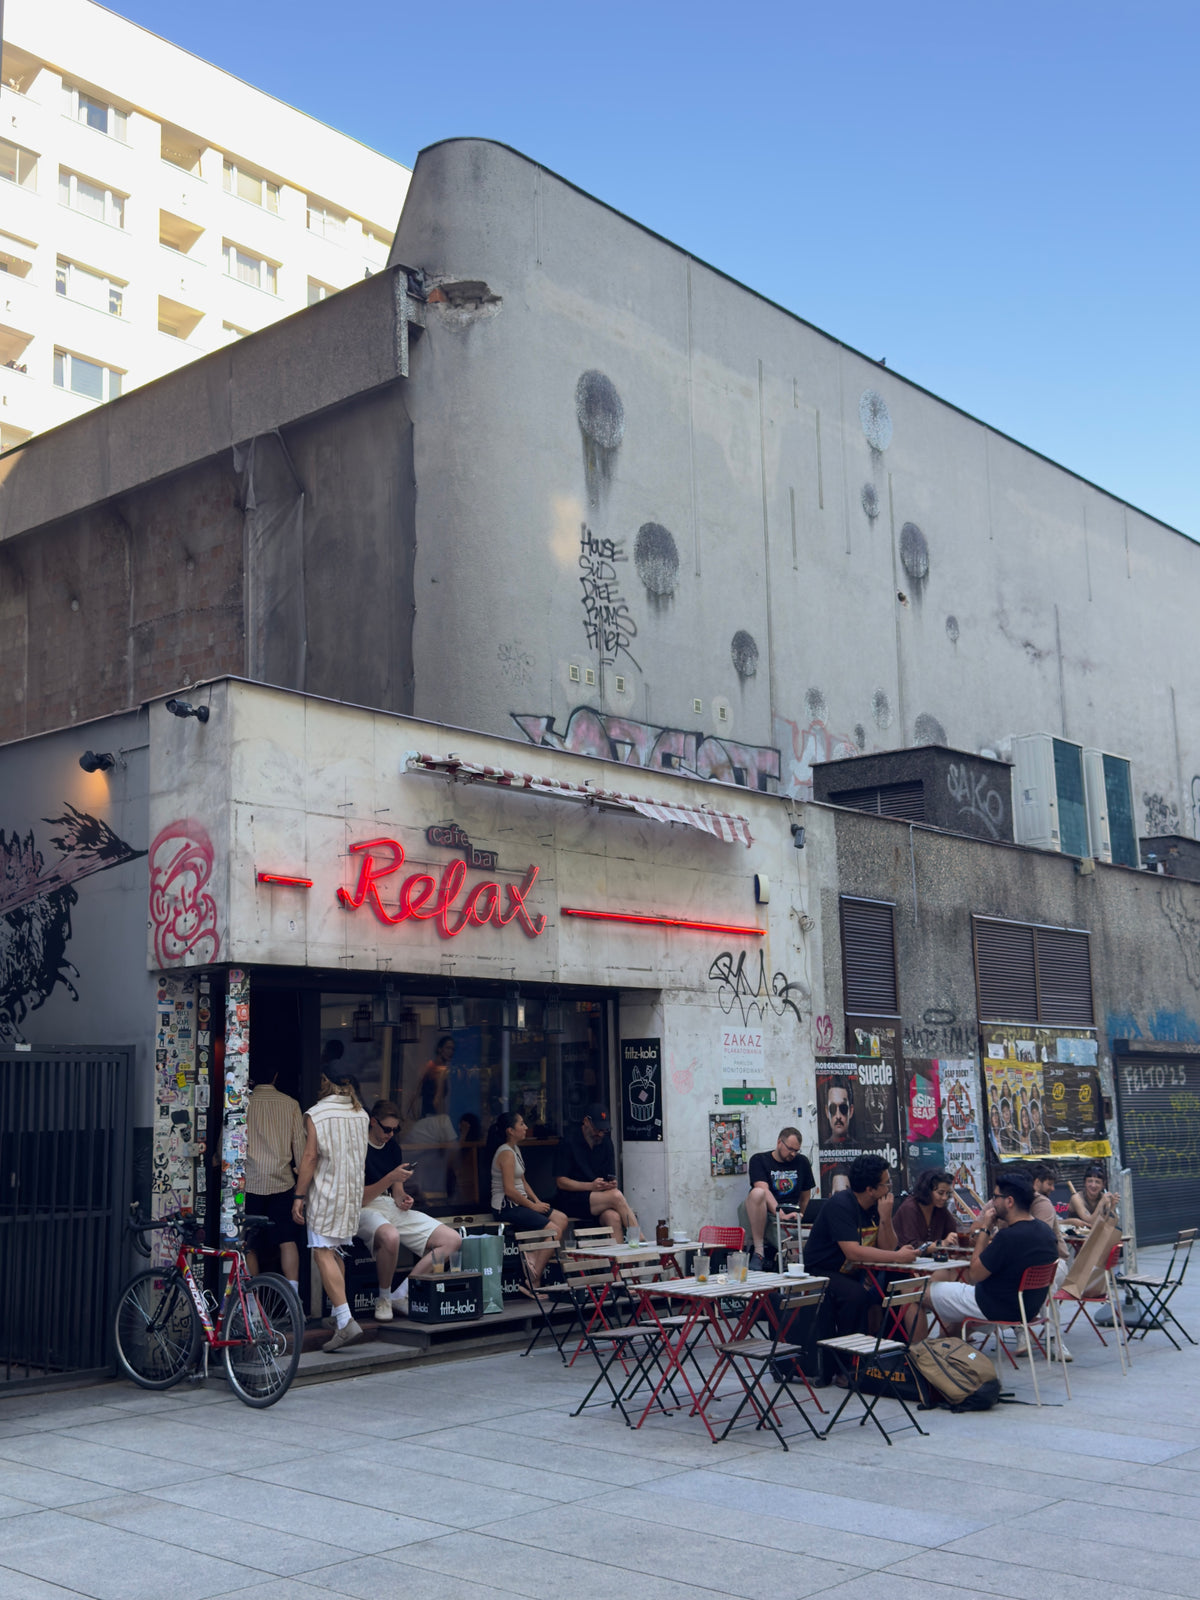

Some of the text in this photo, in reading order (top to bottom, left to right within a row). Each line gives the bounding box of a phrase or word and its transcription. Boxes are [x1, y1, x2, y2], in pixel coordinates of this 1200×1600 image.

[432, 824, 469, 846] cafe
[472, 849, 498, 867] bar
[337, 838, 547, 939] Relax
[724, 1033, 762, 1047] ZAKAZ
[624, 1046, 657, 1059] fritz-kola
[858, 1060, 893, 1085] suede
[440, 1299, 476, 1316] fritz-kola
